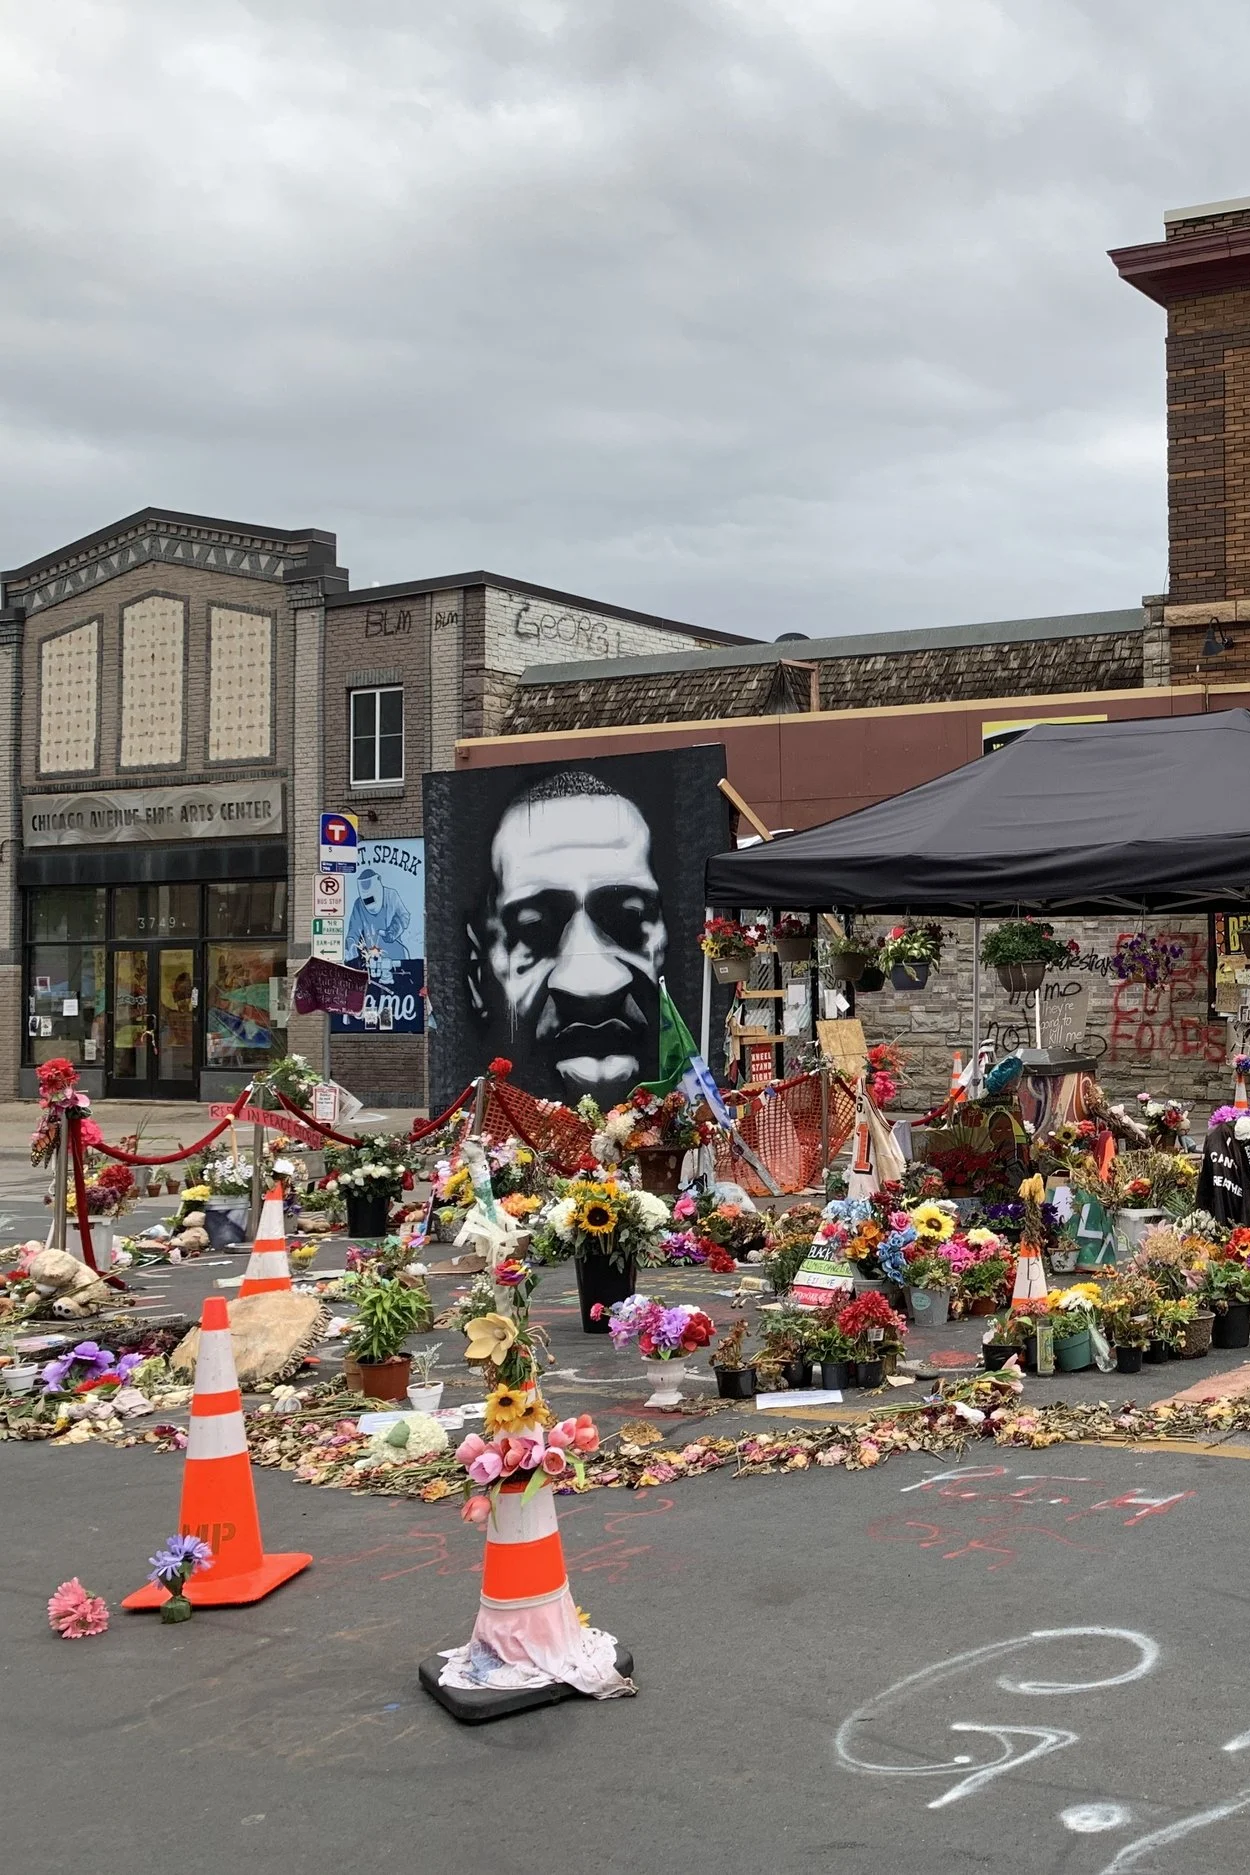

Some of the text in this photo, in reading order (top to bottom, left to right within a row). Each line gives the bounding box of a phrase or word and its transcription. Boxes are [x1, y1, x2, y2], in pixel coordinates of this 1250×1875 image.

[365, 609, 411, 637] BLM
[31, 800, 272, 832] CHICAGO AVENUE FIRE ARTS CENTER
[373, 844, 422, 876] SPARK
[137, 916, 176, 929] 3749
[1066, 1030, 1083, 1041] me
[751, 1062, 772, 1072] STAND
[751, 1072, 772, 1082] FIGHT
[247, 1109, 260, 1122] IN
[807, 1245, 832, 1261] BLACK
